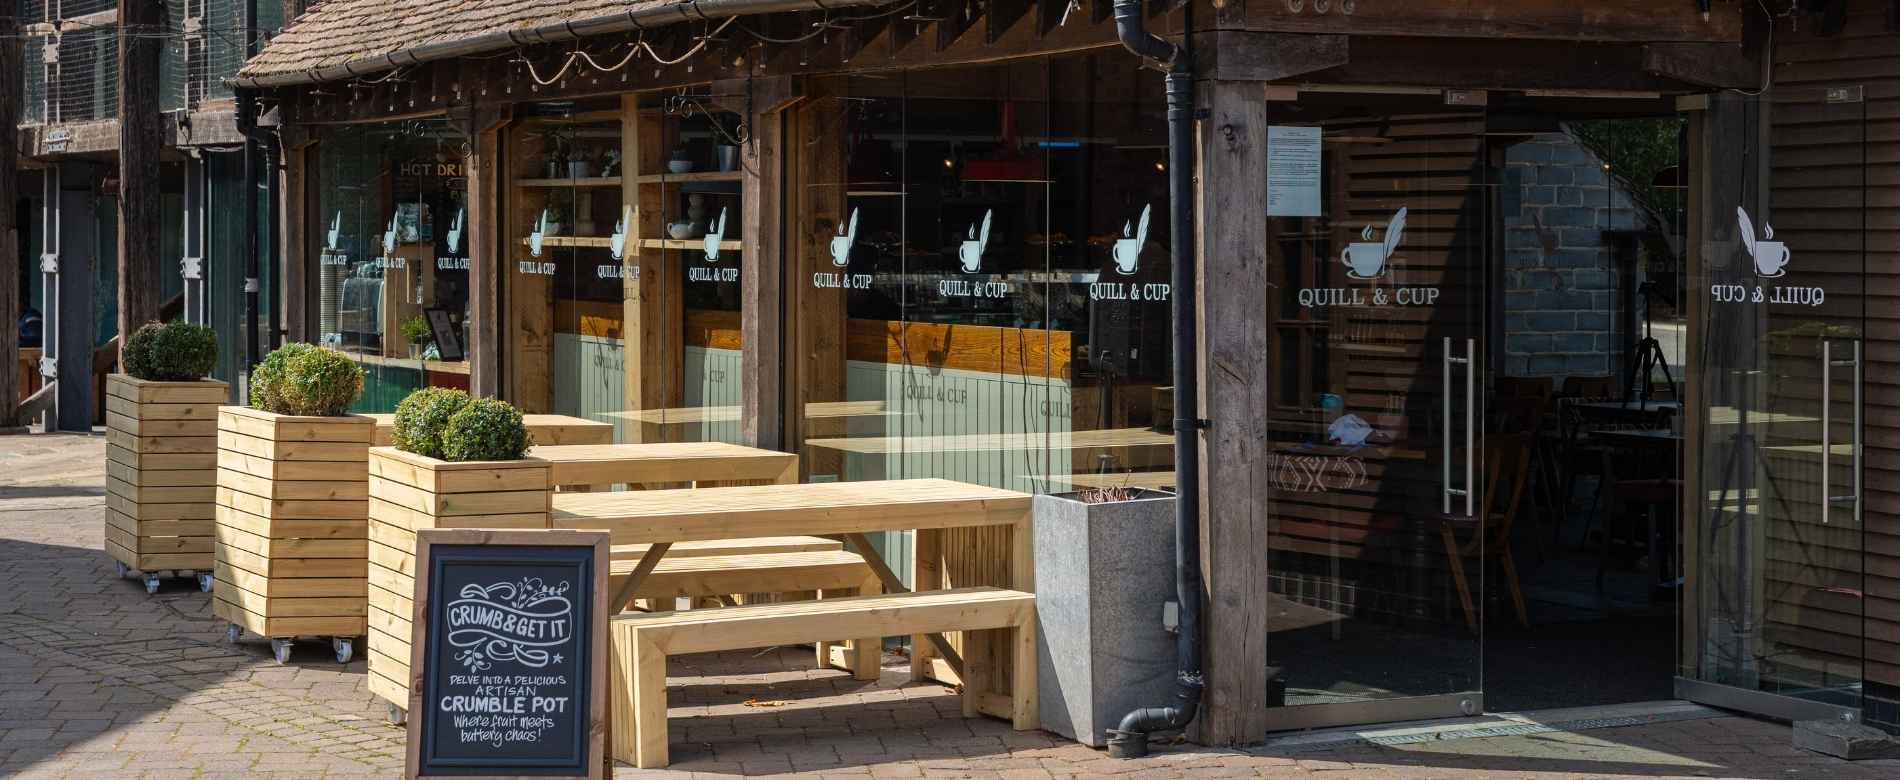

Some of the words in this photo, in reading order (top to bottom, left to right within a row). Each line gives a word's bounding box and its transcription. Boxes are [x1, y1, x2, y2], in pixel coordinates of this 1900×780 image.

[437, 163, 463, 176] DRI
[438, 257, 455, 270] QUILL
[519, 261, 537, 275] QUILL
[537, 263, 543, 274] &
[543, 263, 556, 275] CUP
[598, 265, 617, 278] QUILL
[689, 267, 712, 282] QUILL
[714, 268, 720, 281] &
[722, 268, 738, 282] CUP
[814, 272, 841, 288] QUILL
[843, 274, 851, 288] &
[852, 274, 872, 289] CUP
[939, 279, 971, 298] QUILL
[974, 281, 982, 297] &
[985, 281, 1008, 299] CUP
[1089, 282, 1127, 300] QUILL
[1130, 283, 1141, 300] &
[1144, 283, 1170, 301] CUP
[1298, 288, 1365, 308] QUILL
[1372, 288, 1389, 305] &
[1396, 287, 1440, 305] CUP
[551, 619, 566, 638] IT
[450, 675, 480, 686] DELVE
[482, 675, 503, 685] INTO
[504, 676, 511, 685] A
[513, 675, 567, 686] DELICIOUS
[475, 685, 536, 697] ARTISAN
[440, 696, 526, 713] CRUMBLE
[532, 697, 569, 713] POT
[454, 714, 489, 728] Where
[490, 714, 518, 730] fruit
[520, 714, 555, 729] meets
[461, 729, 503, 748] buttery
[505, 728, 541, 742] chaos!
